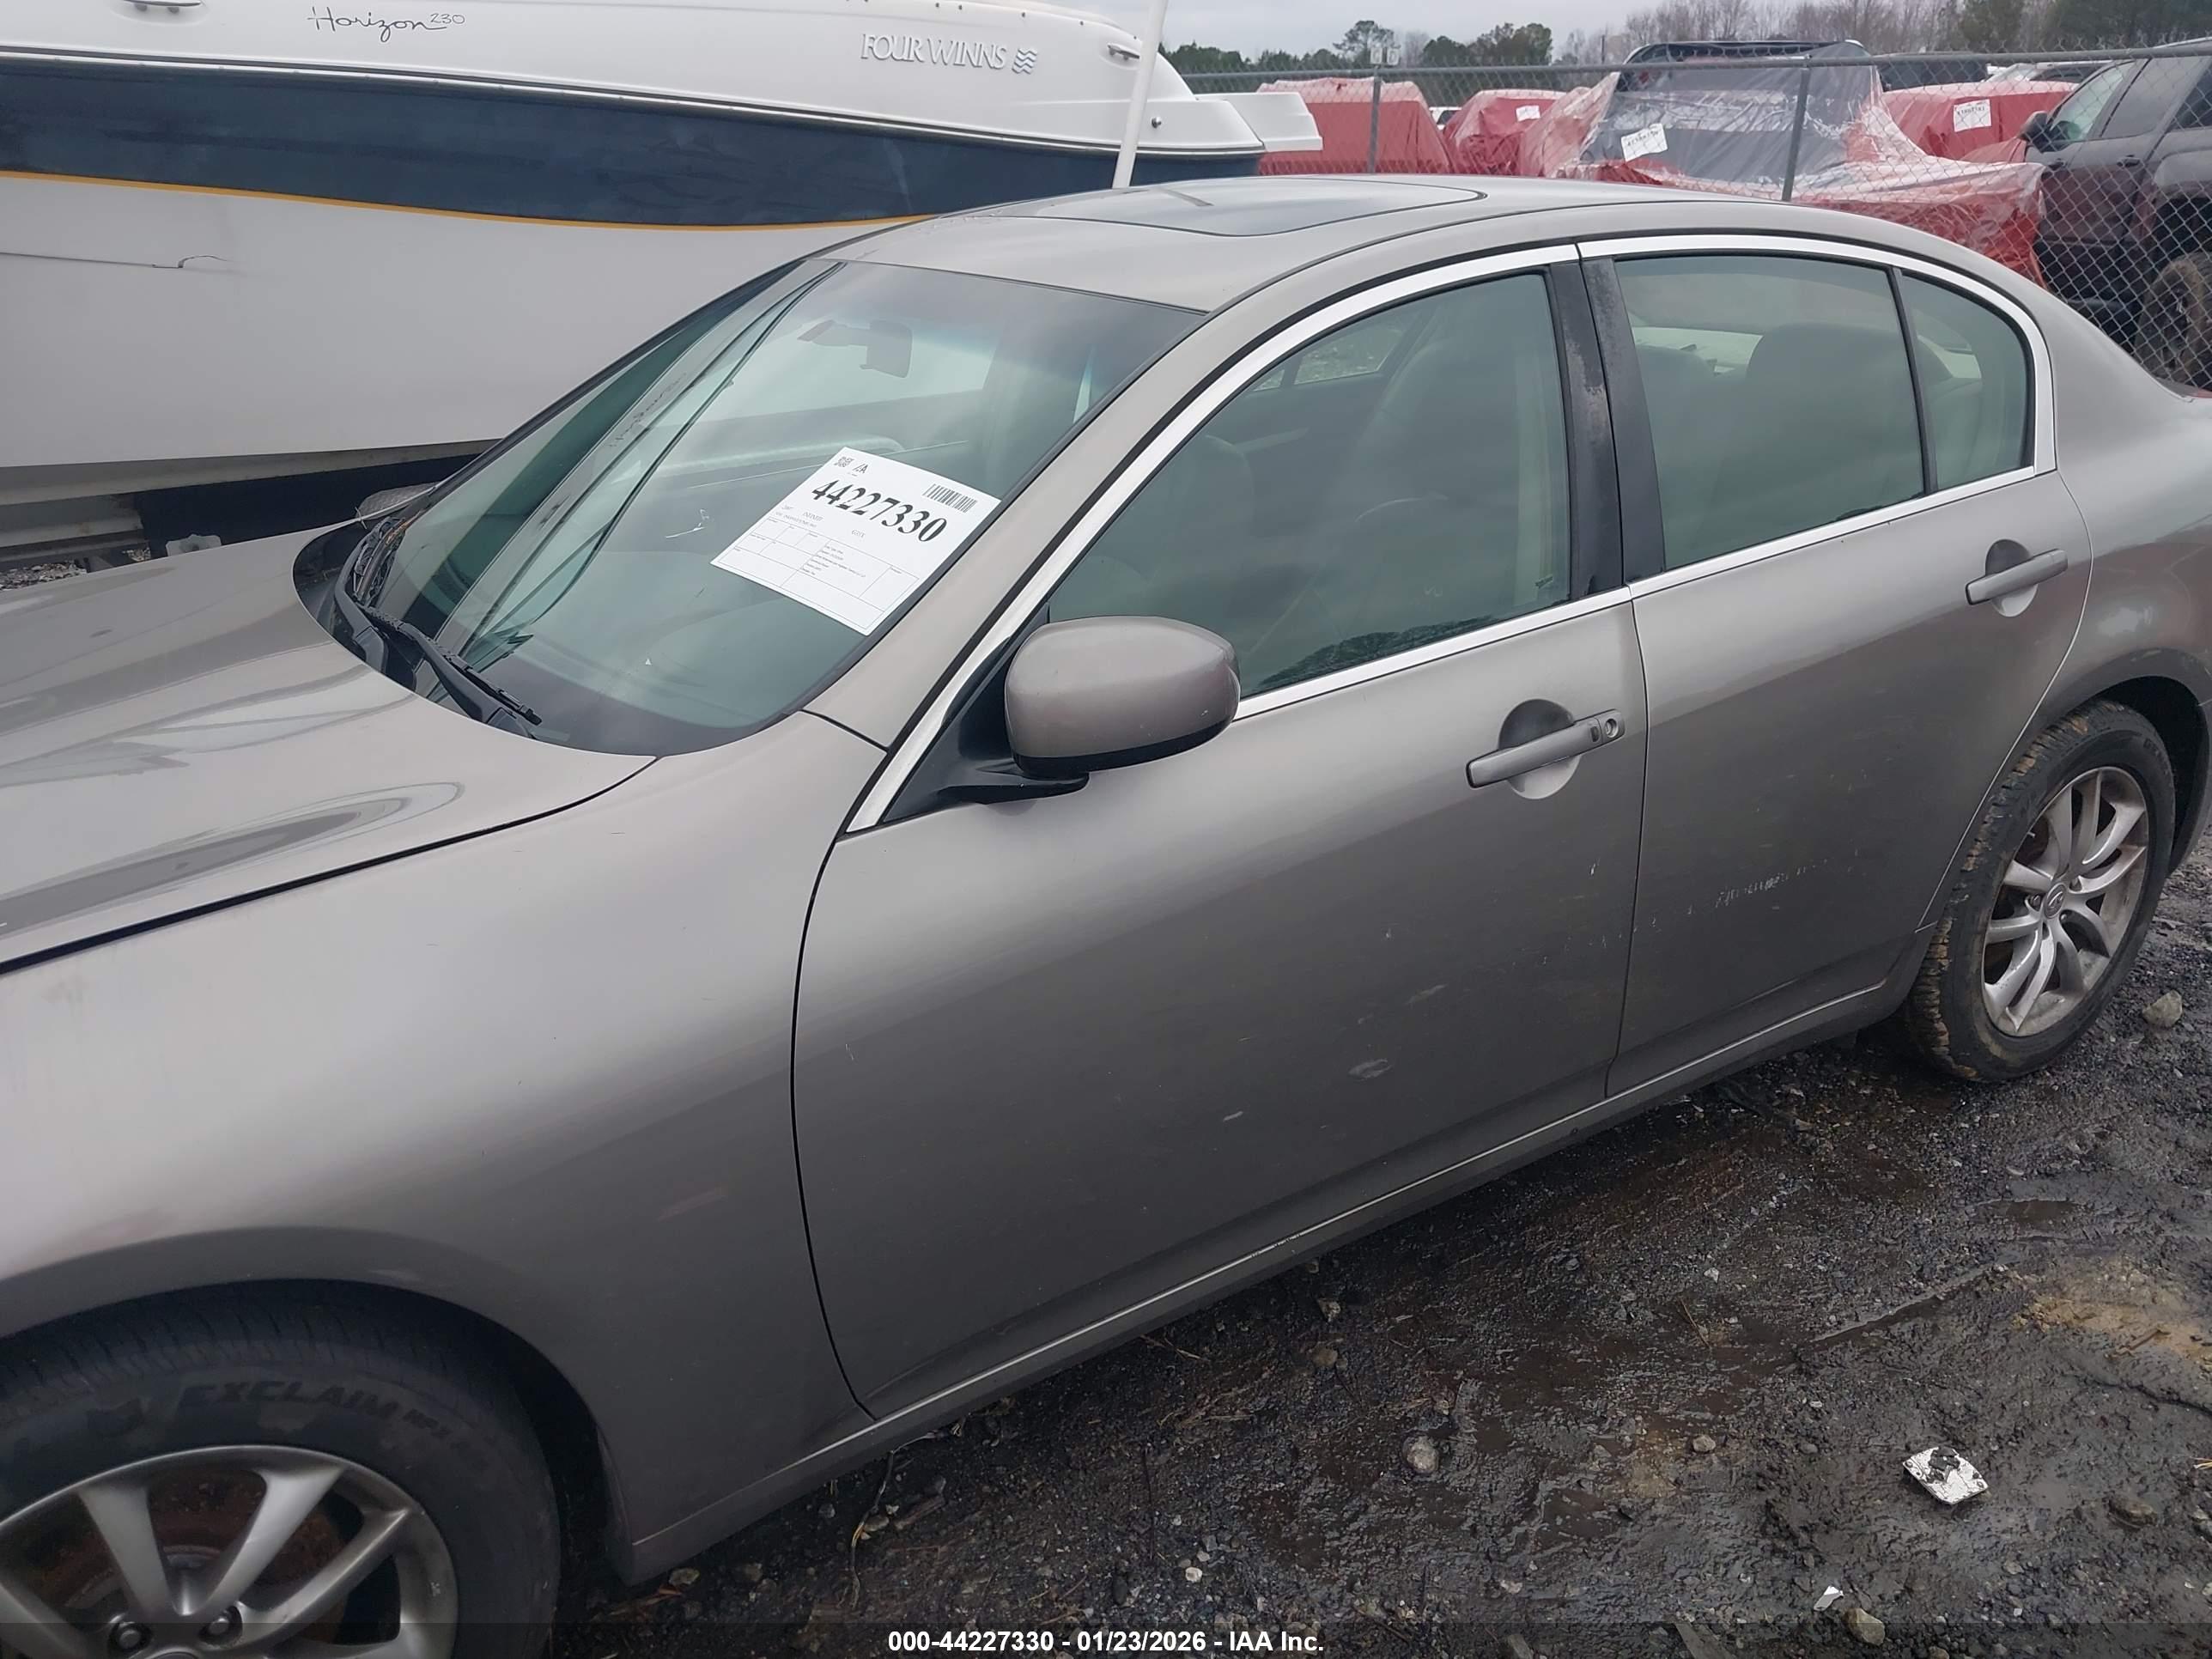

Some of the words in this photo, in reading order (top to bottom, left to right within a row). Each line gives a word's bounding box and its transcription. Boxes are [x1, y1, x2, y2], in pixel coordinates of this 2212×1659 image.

[307, 7, 447, 42] Horizon
[430, 13, 465, 24] 230
[860, 33, 925, 63] FOUR
[927, 38, 1007, 70] WINNS
[811, 478, 948, 543] 44227330
[181, 1380, 400, 1419] EXCLAIM
